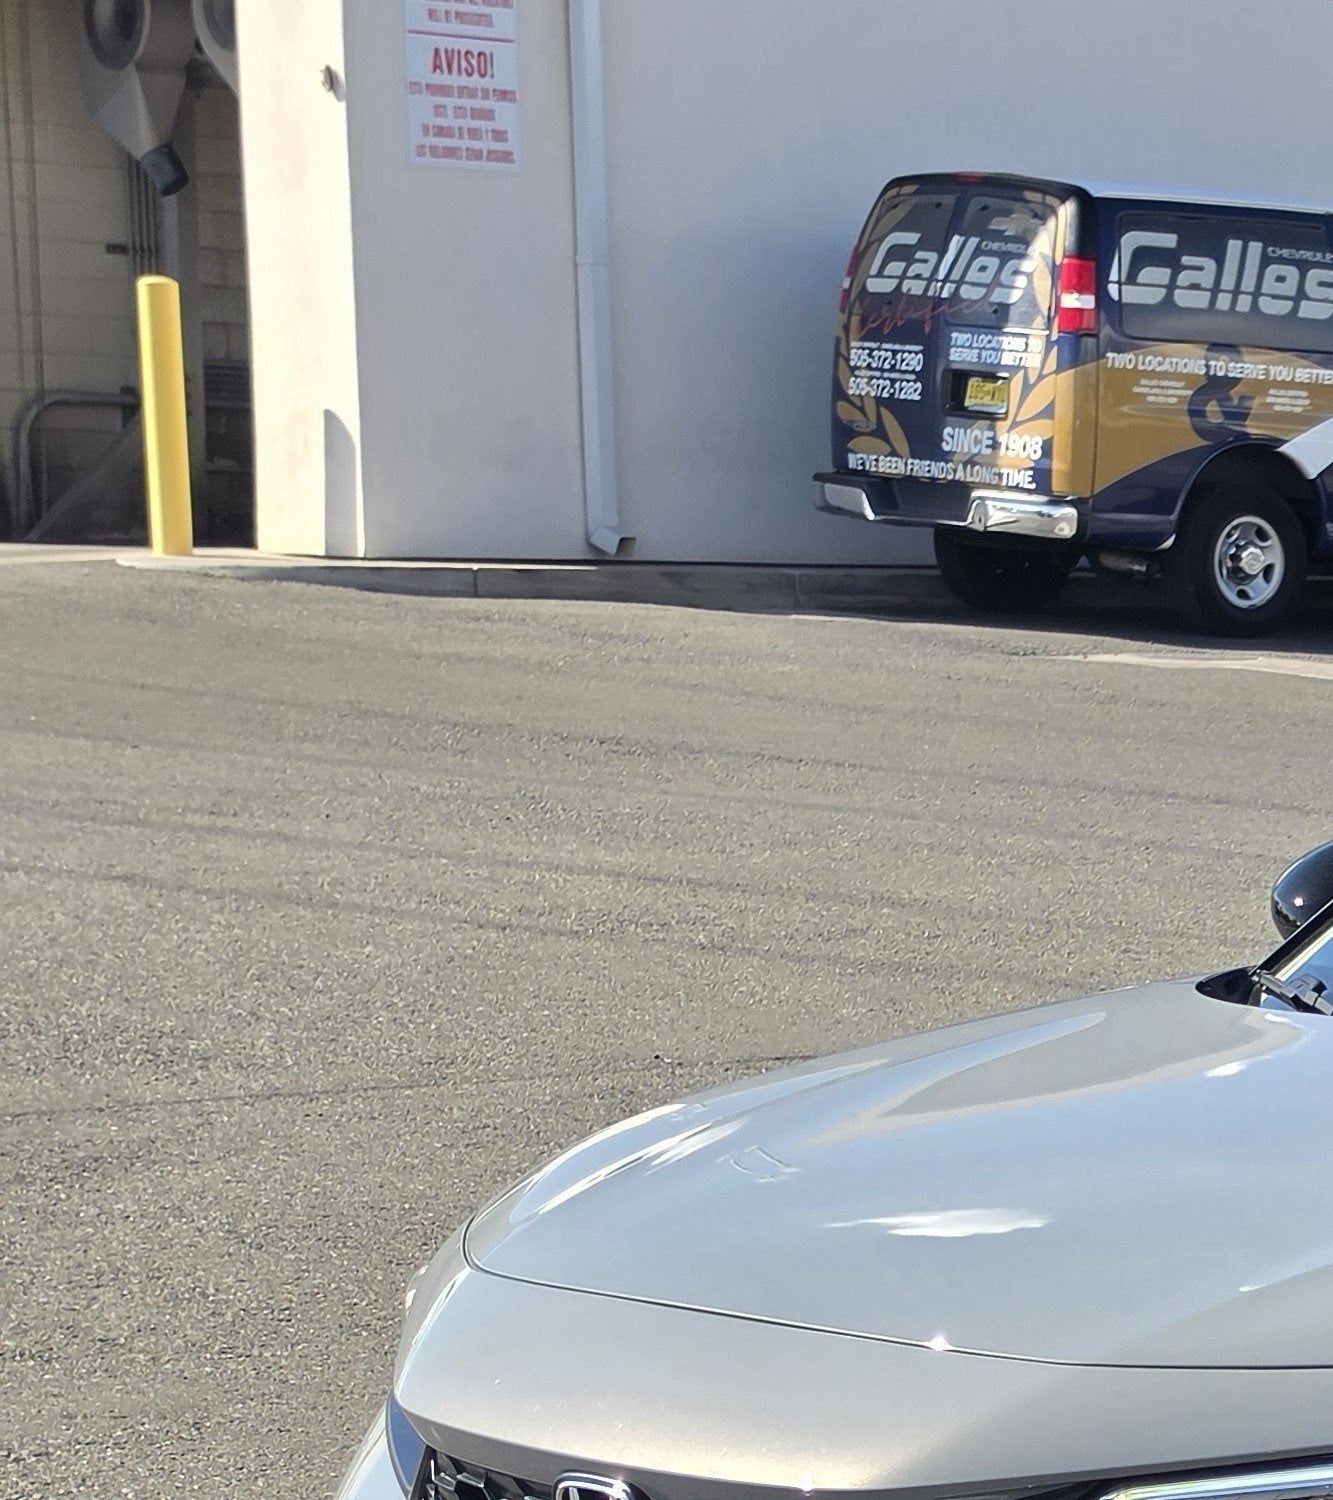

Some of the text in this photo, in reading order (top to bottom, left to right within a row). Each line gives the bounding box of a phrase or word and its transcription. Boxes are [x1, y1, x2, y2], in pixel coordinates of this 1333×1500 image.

[431, 47, 495, 79] AVISO!
[866, 231, 1039, 305] Galles
[981, 349, 1001, 364] YOU
[1105, 352, 1136, 369] TWO
[1136, 355, 1207, 375] LOCATIONS
[1208, 359, 1226, 376] TO
[1227, 361, 1267, 379] SERVE
[1267, 364, 1294, 381] YOU
[941, 426, 1044, 461] SINCE 1908
[878, 455, 906, 475] BEEN
[906, 458, 955, 481] FRIENDS
[955, 463, 965, 482] A
[965, 464, 999, 485] LONG
